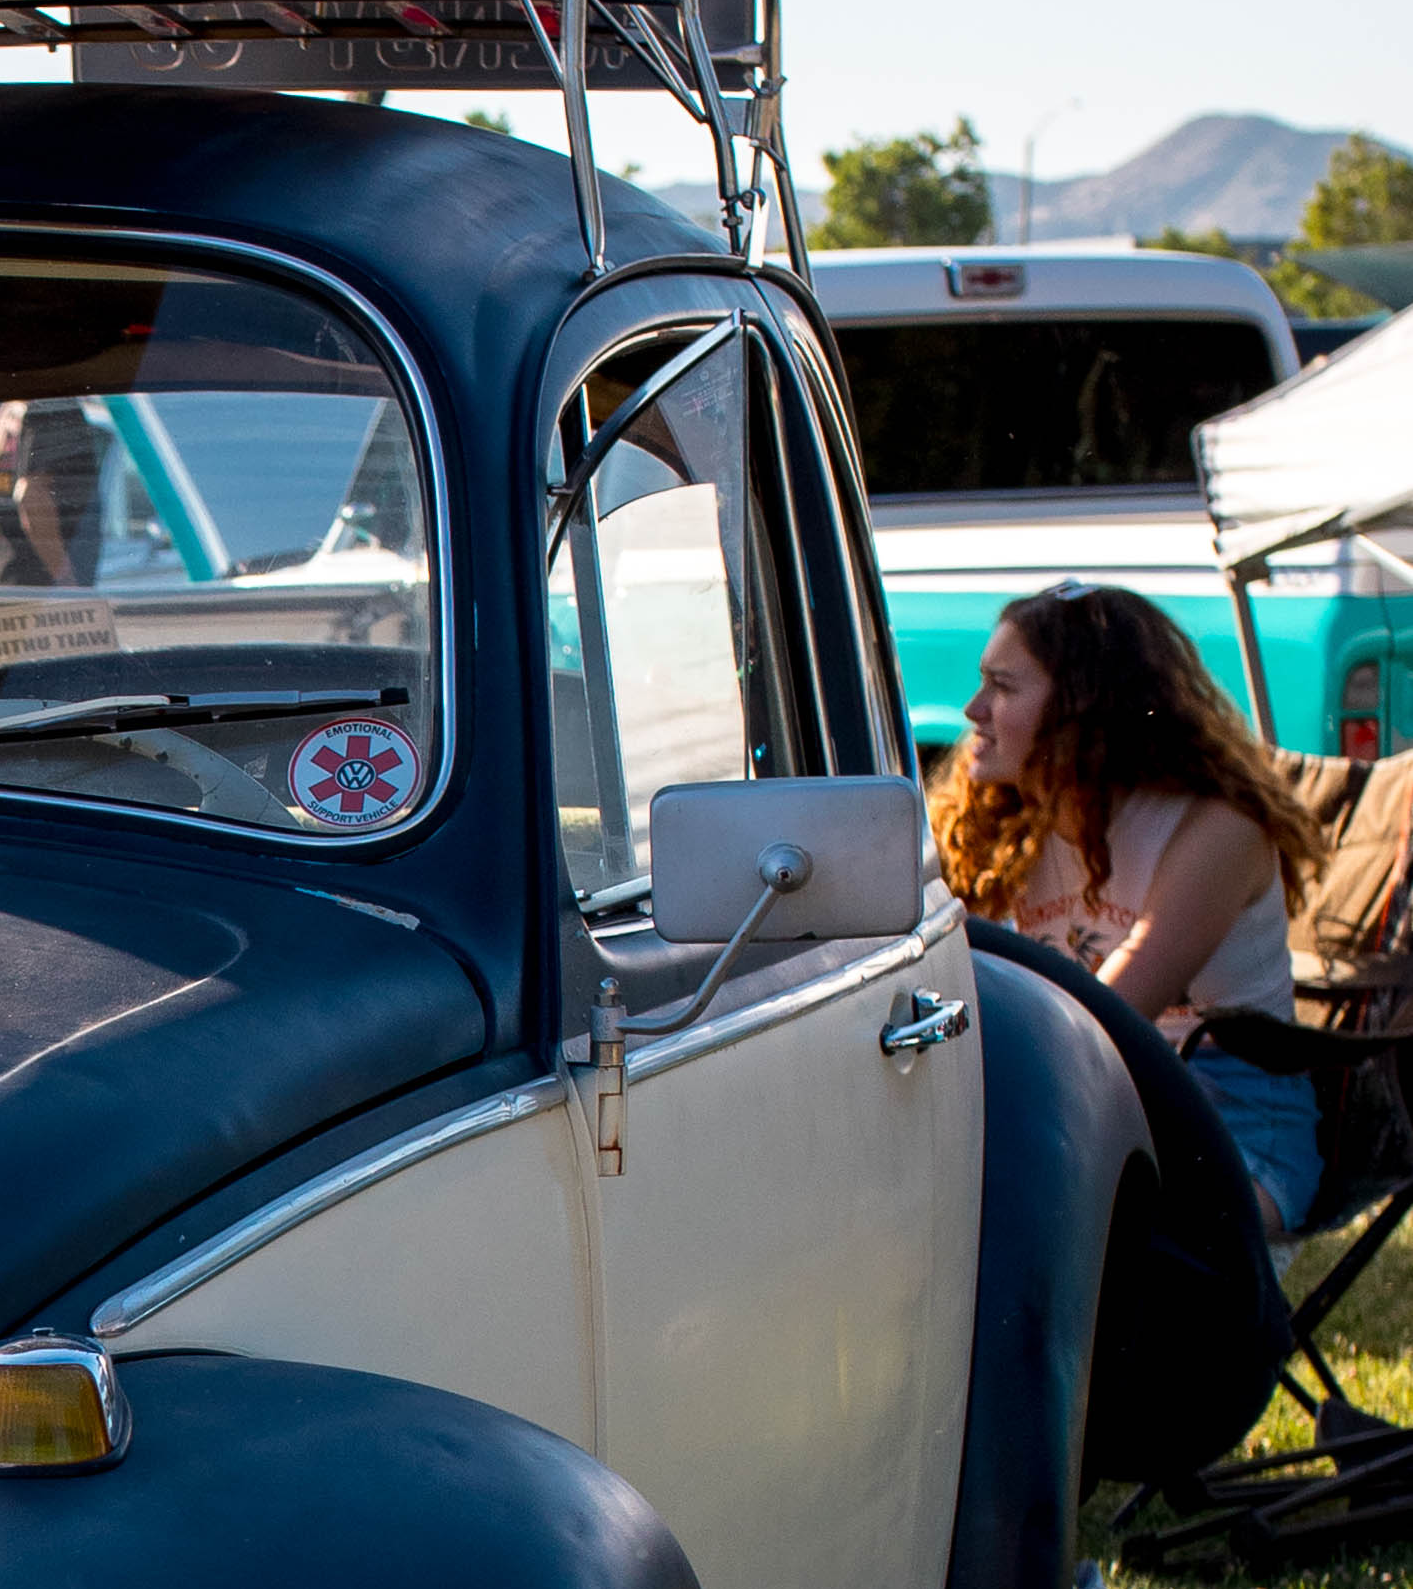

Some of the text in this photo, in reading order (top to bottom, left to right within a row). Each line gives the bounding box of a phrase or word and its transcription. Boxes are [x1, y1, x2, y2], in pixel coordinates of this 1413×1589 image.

[324, 723, 393, 741] EMOTIONAL
[307, 799, 399, 824] SUPPORT VEHICLE
